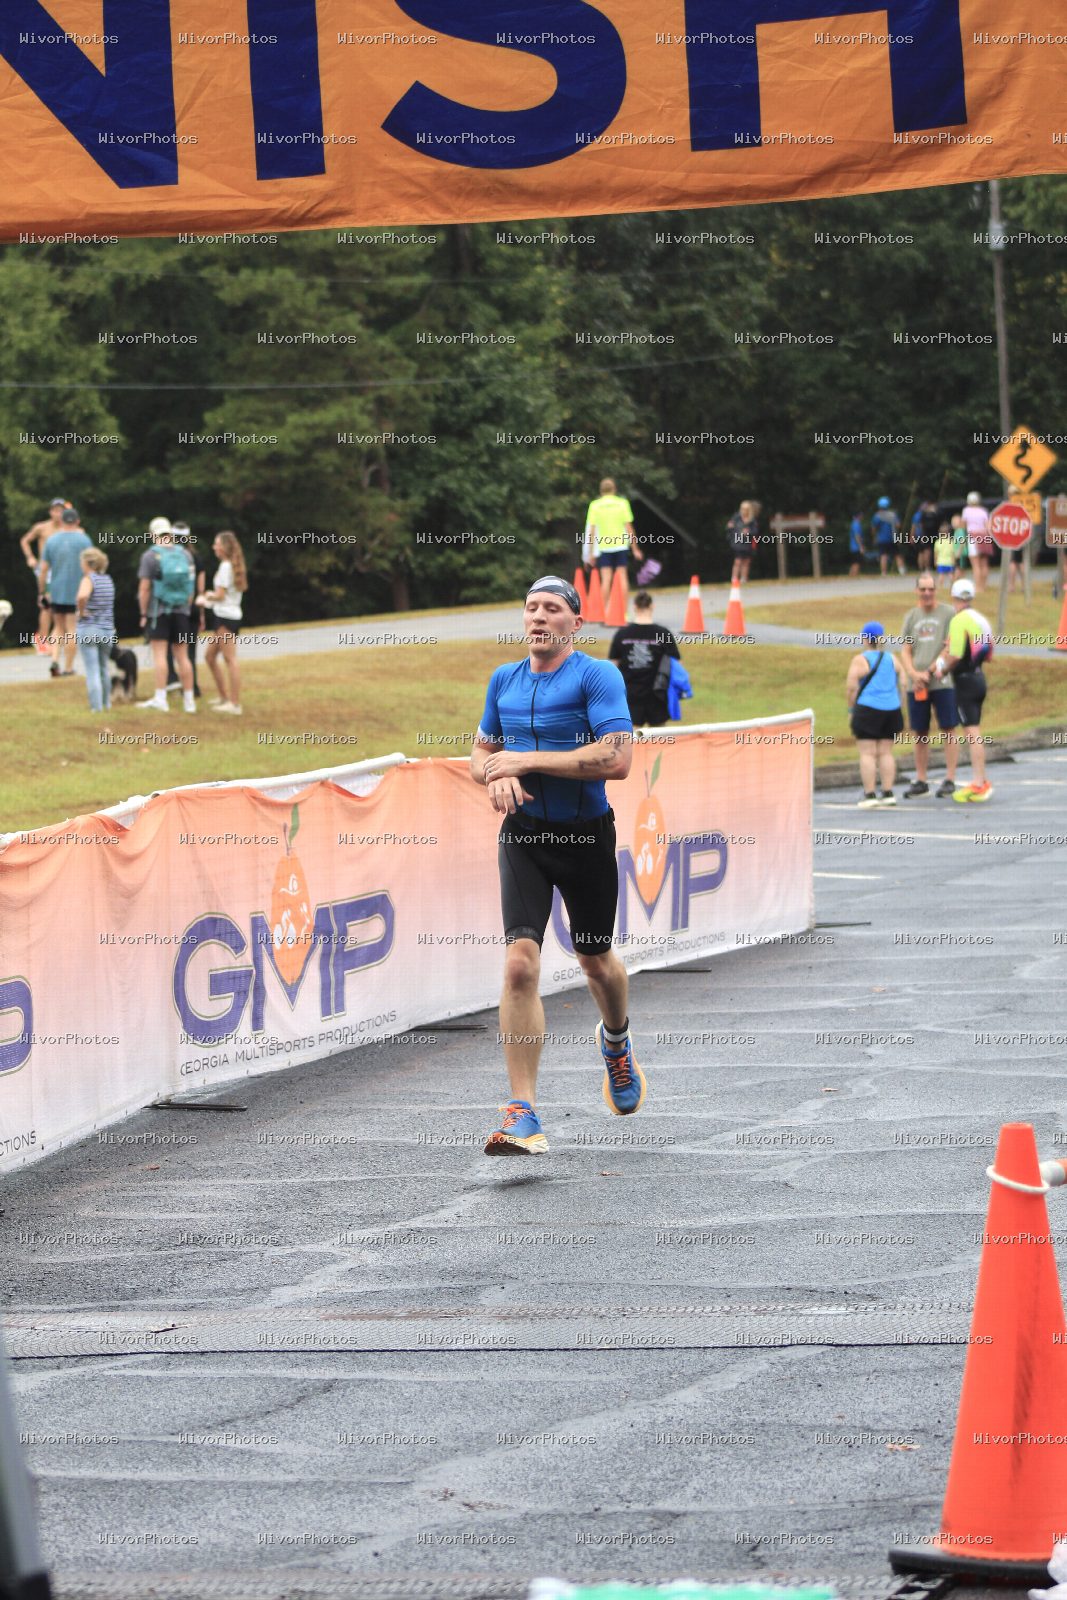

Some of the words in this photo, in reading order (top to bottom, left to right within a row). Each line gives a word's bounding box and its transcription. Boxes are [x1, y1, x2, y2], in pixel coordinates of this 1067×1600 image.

[993, 516, 1029, 536] STOP
[172, 890, 396, 1048] GMP
[623, 948, 665, 964] TISPORTS
[667, 932, 726, 954] PRODUCTIONS
[235, 1036, 315, 1063] MULTISPORTS
[319, 1010, 397, 1045] PRODUCTIONS
